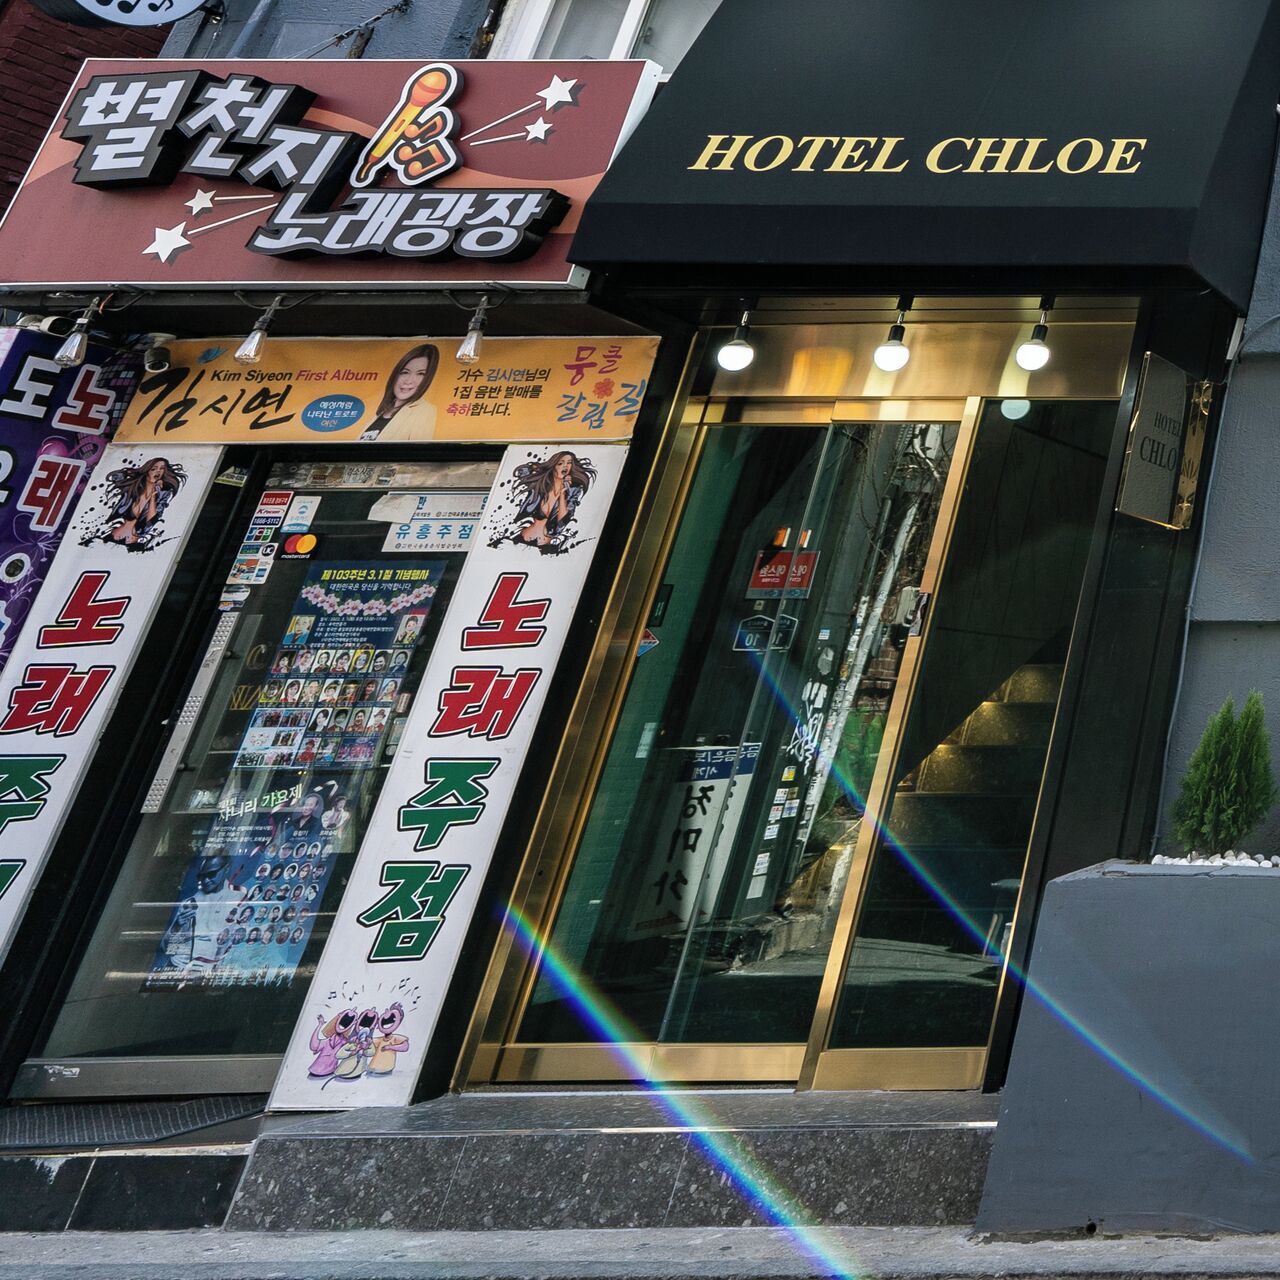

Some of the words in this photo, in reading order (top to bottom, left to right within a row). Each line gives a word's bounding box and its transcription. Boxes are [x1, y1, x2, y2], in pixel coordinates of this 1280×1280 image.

[80, 77, 335, 186] 별천지
[688, 134, 909, 173] HOTEL
[925, 136, 1148, 175] CHLOE
[253, 188, 543, 252] 노래광장
[211, 370, 244, 381] Kim
[245, 369, 292, 384] Siyeon
[296, 369, 328, 381] First
[330, 369, 378, 381] Album
[457, 368, 484, 382] 가수
[486, 368, 551, 382] 김시연님의
[136, 367, 296, 436] 김시연
[453, 385, 473, 399] 1집
[474, 385, 502, 399] 음반
[505, 385, 543, 399] 발매를
[446, 402, 511, 417] 축하합니다.
[247, 528, 271, 538] JCB
[395, 523, 474, 540] 유흥주점
[358, 571, 552, 963] 노래주점
[261, 784, 303, 808] 가요제
